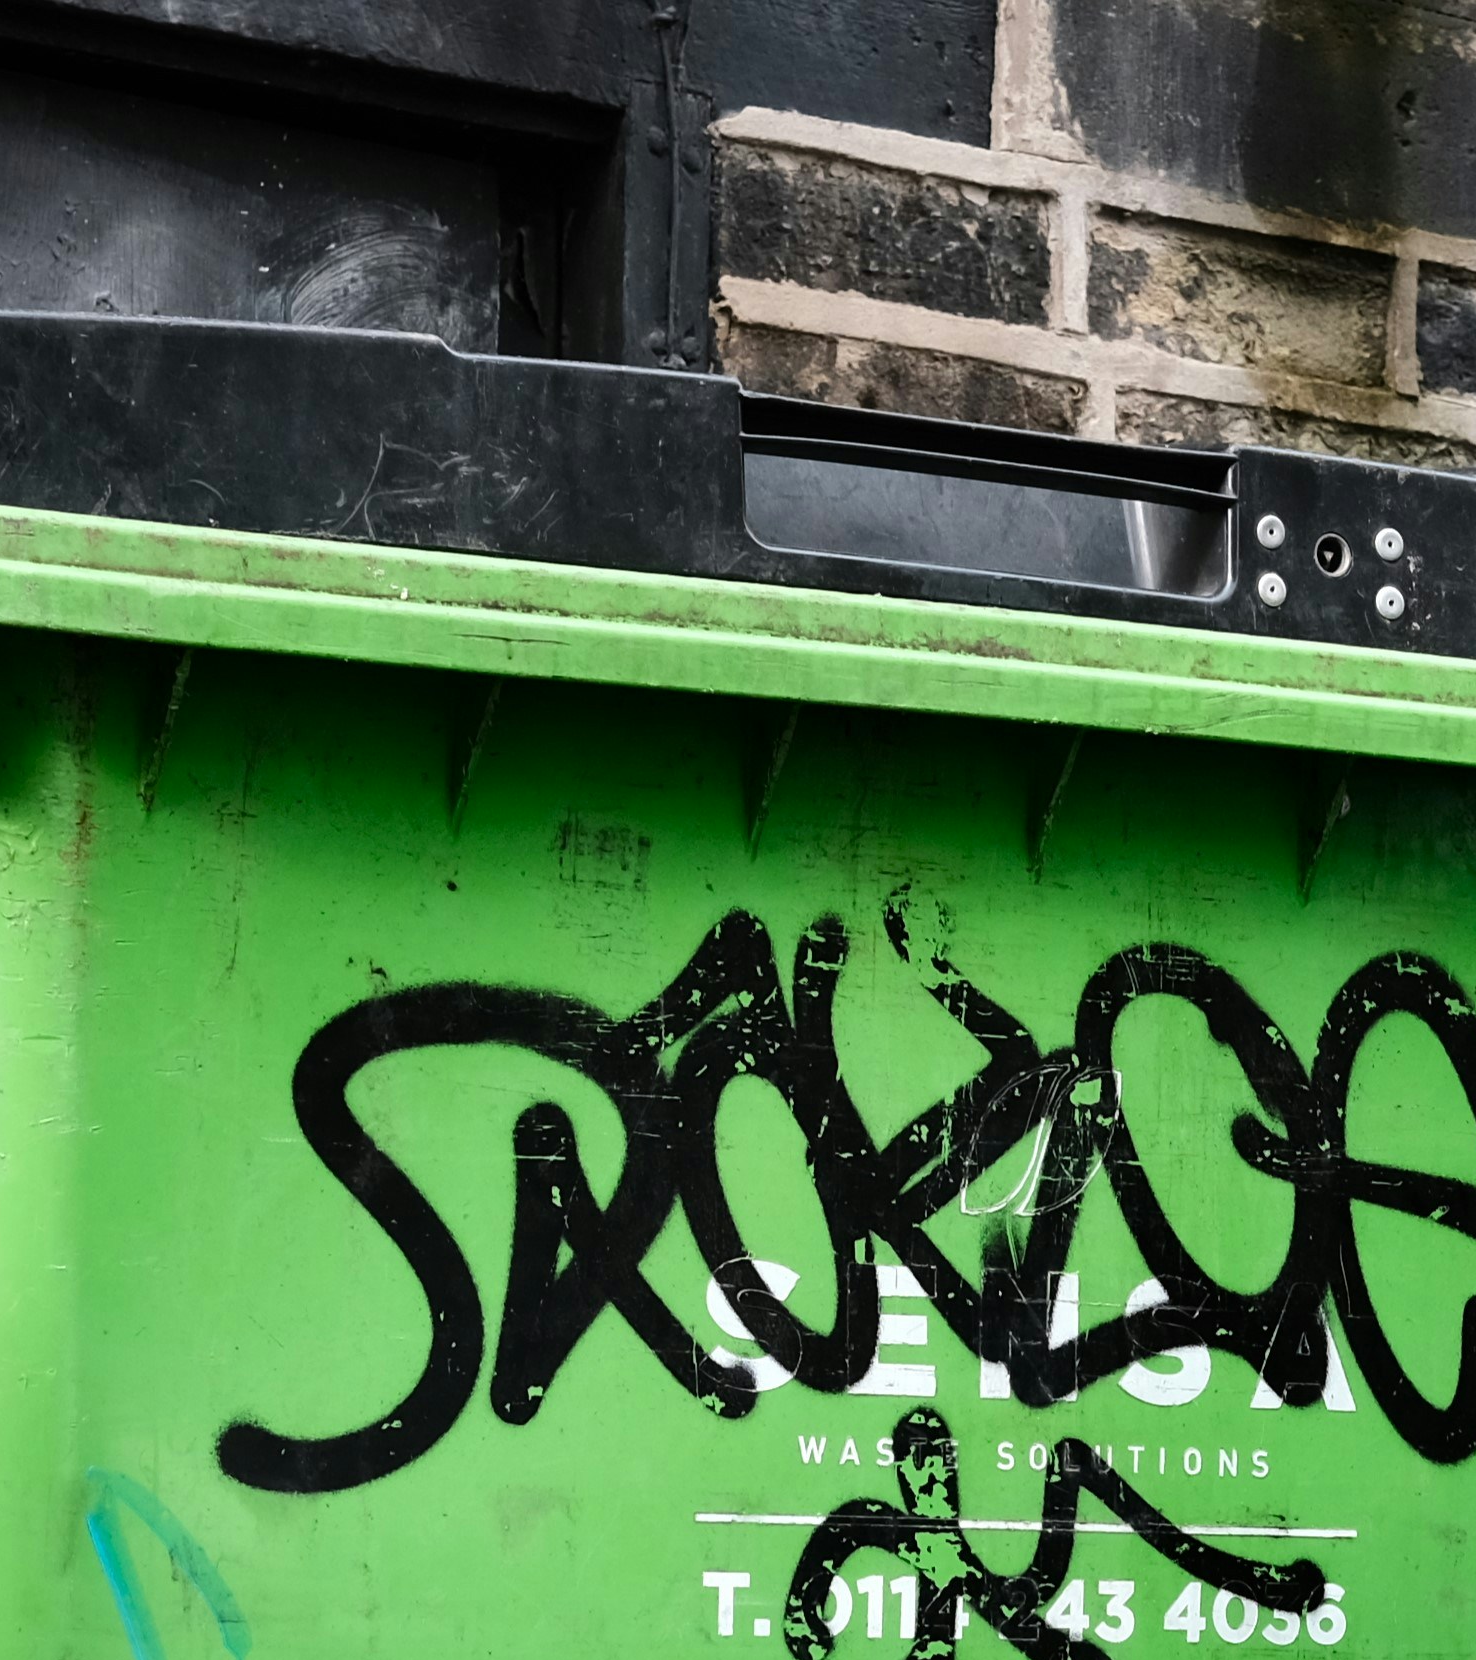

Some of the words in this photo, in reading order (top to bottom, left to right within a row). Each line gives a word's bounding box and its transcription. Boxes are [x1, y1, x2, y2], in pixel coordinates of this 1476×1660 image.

[997, 1440, 1270, 1479] SOLUTIONS
[703, 1572, 770, 1637] T.
[1163, 1579, 1347, 1647] 4036
